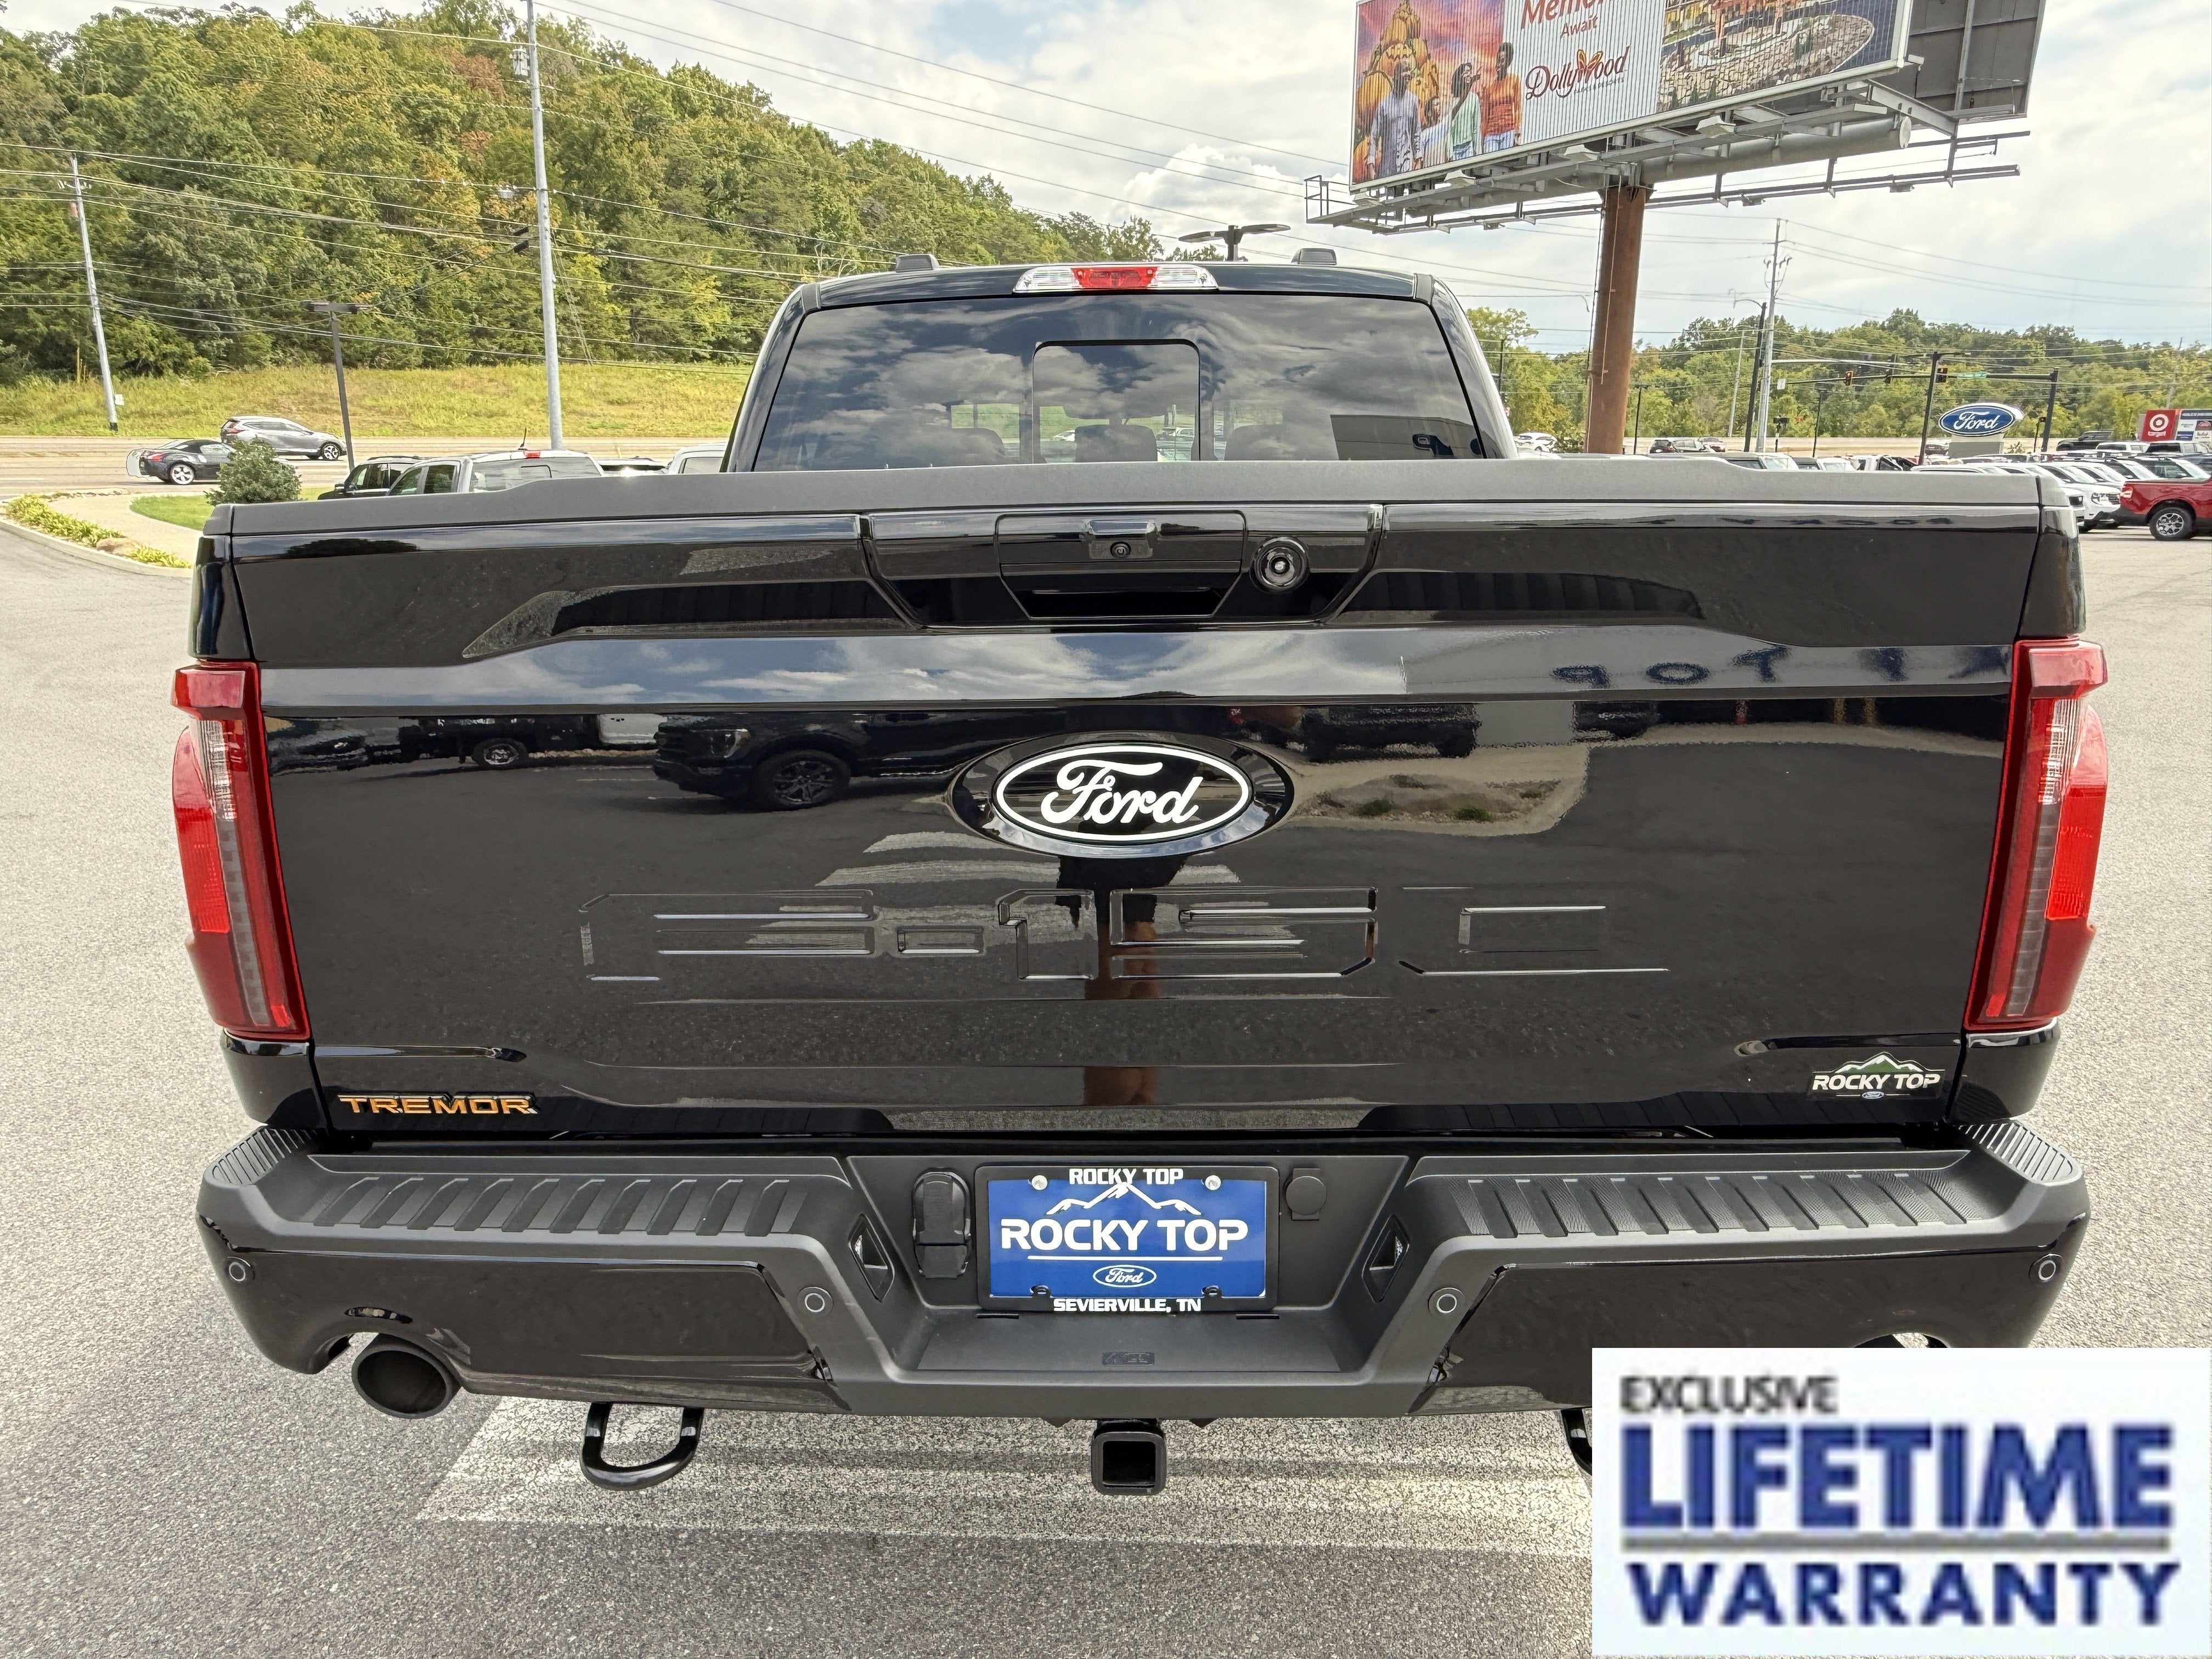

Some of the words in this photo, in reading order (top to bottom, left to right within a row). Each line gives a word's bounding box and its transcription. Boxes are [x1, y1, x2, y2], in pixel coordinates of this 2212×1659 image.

[1560, 15, 1599, 38] Await
[1526, 46, 1631, 100] Dollywood
[1953, 411, 2001, 430] Ford
[1040, 759, 1203, 825] Ford
[1812, 1074, 1891, 1091] ROCKY
[1894, 1074, 1940, 1090] TOP
[337, 1094, 539, 1115] TREMOR
[1069, 1168, 1137, 1186] ROCKY
[1143, 1168, 1184, 1185] TOP
[1001, 1218, 1149, 1251] ROCKY
[1156, 1218, 1249, 1251] TOP
[1105, 1268, 1143, 1284] Ford
[1053, 1297, 1172, 1312] SEVIERVILLE,
[1176, 1297, 1201, 1312] TN
